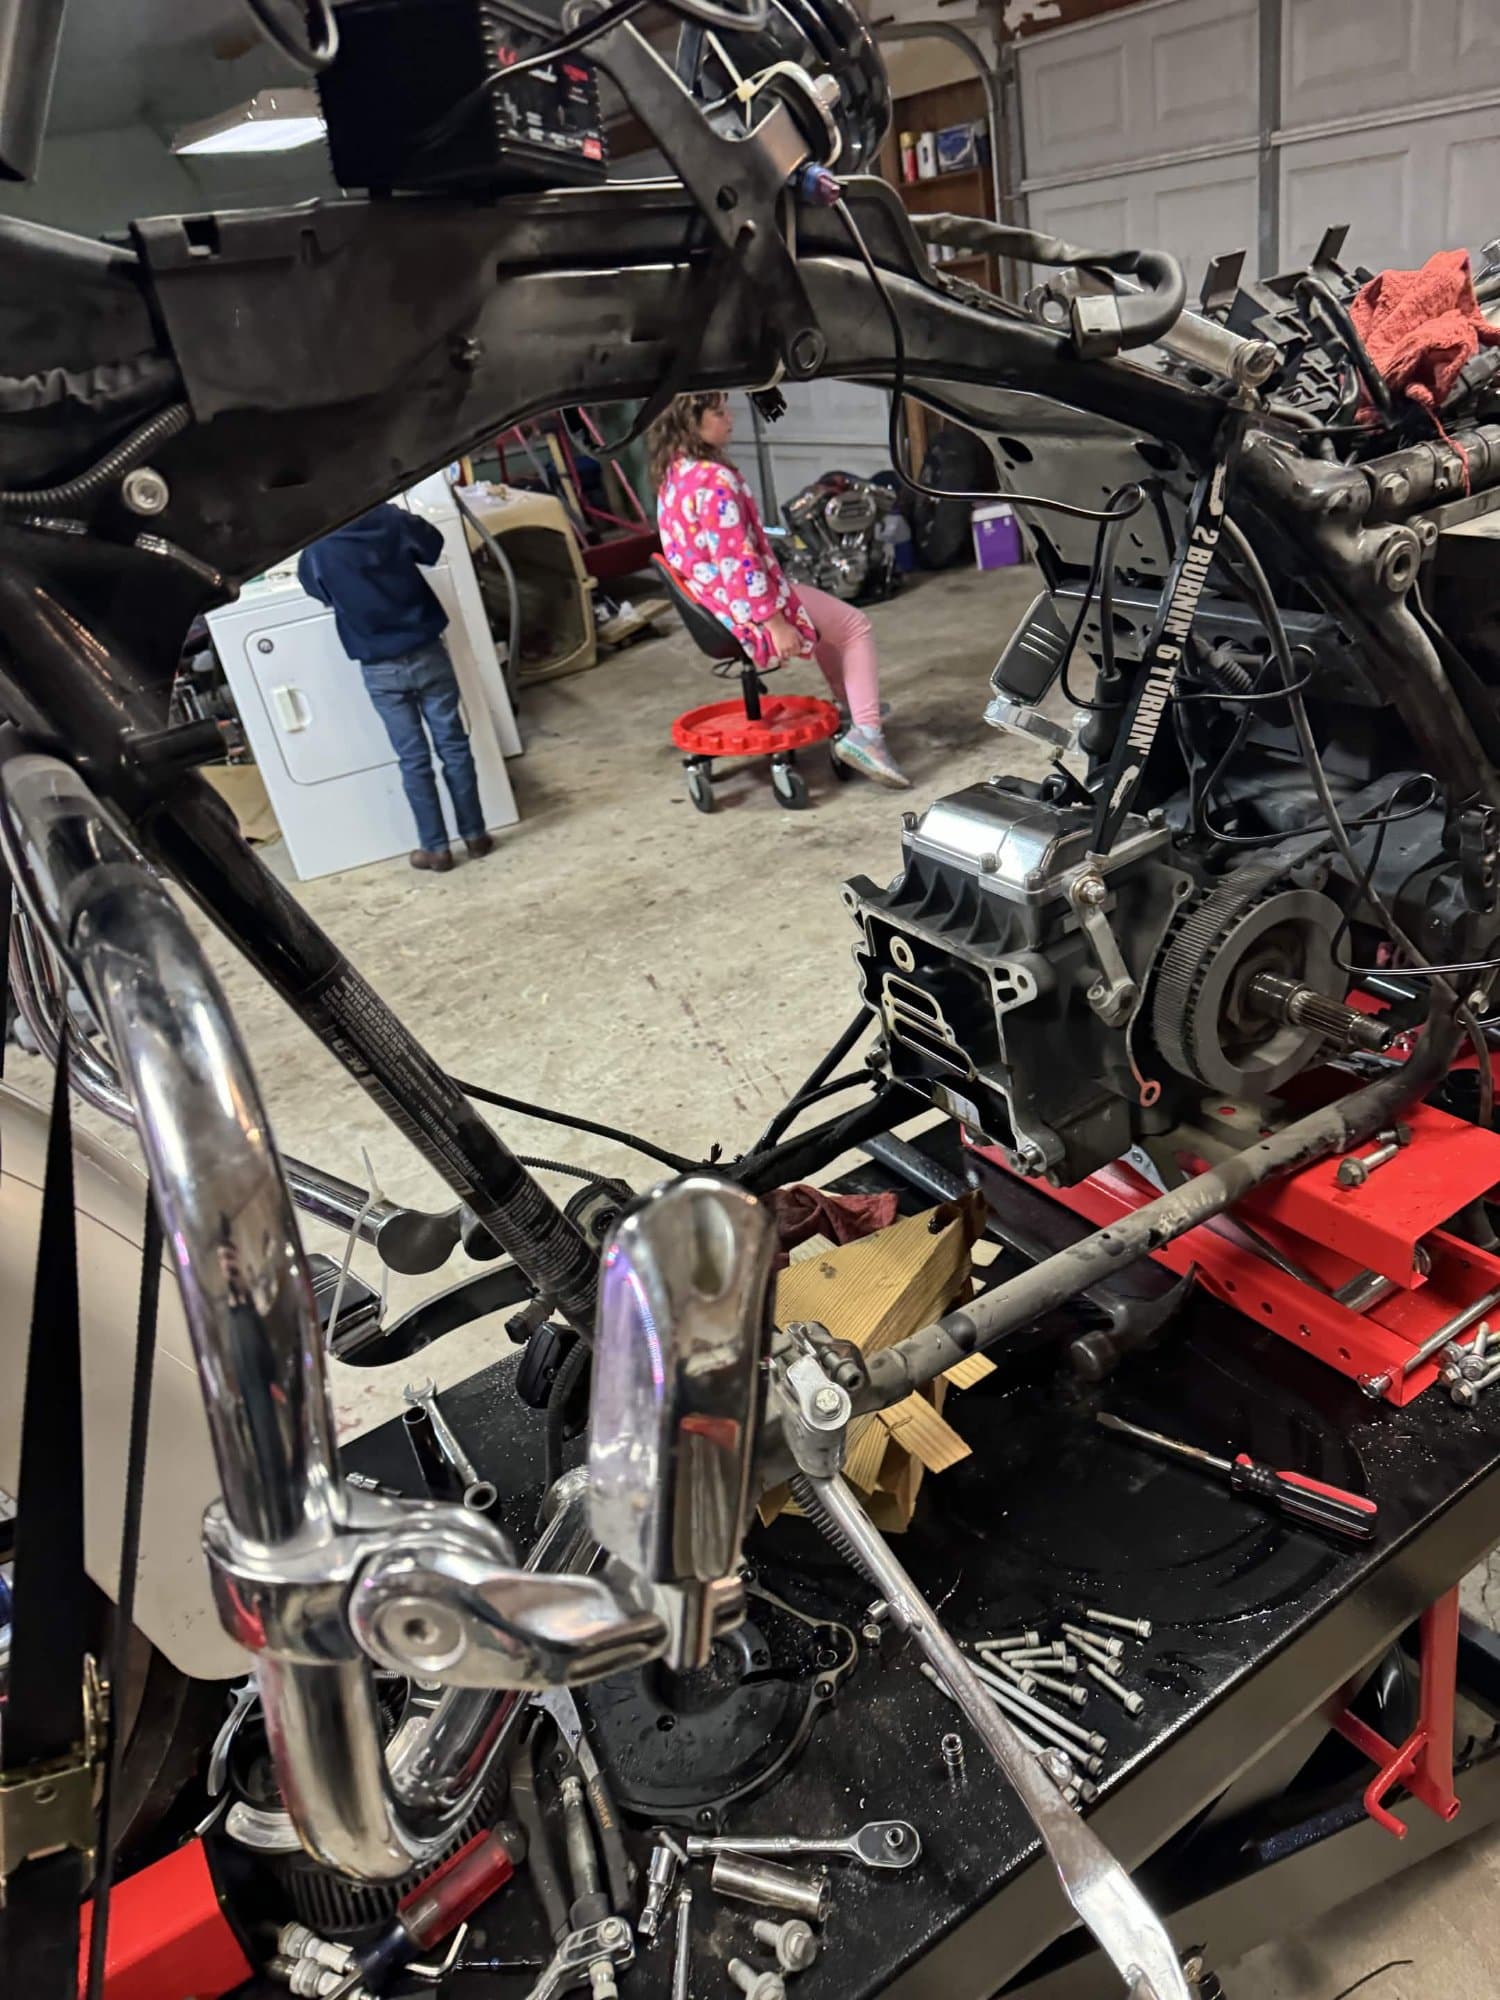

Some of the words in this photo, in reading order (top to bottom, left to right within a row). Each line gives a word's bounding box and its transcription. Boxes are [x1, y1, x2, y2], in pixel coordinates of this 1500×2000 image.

[1192, 525, 1219, 547] 2
[1163, 544, 1214, 643] BURNIN'
[1156, 643, 1182, 661] 6
[1126, 666, 1175, 755] TURNIN'
